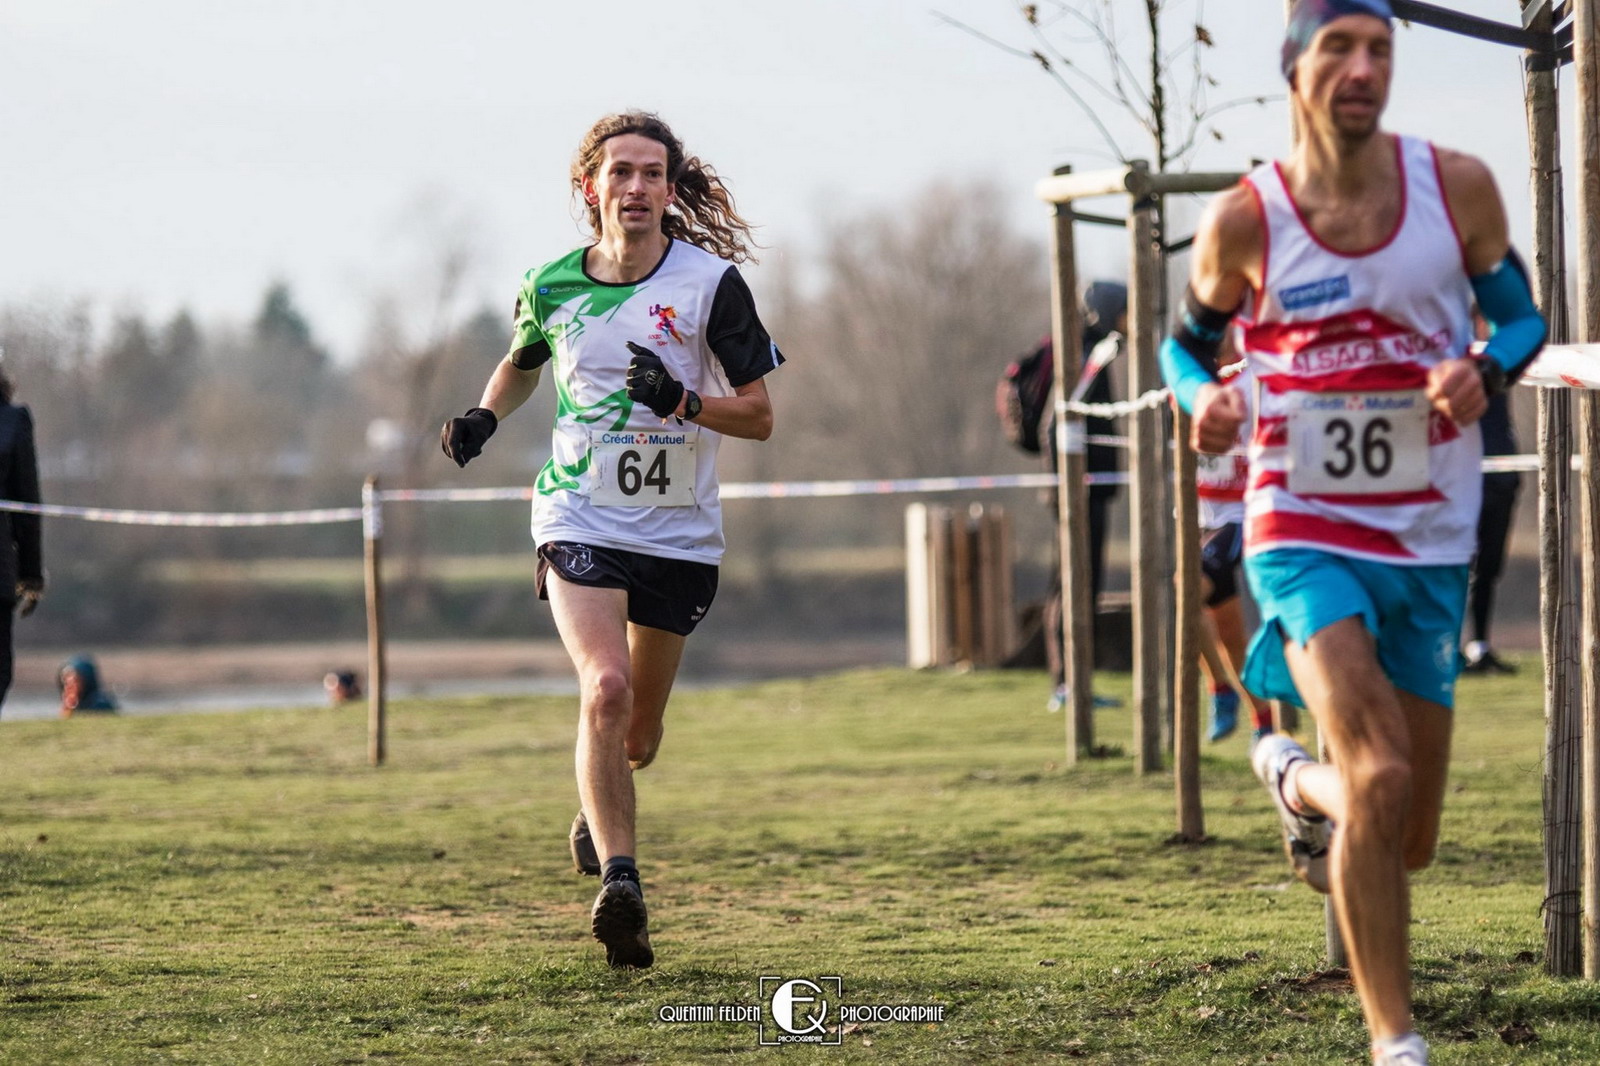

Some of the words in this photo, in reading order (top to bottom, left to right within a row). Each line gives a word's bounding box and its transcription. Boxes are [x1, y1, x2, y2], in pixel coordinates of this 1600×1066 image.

[602, 433, 635, 445] Crédit
[648, 434, 686, 445] Mutuel
[1323, 417, 1394, 479] 36
[617, 449, 671, 496] 64
